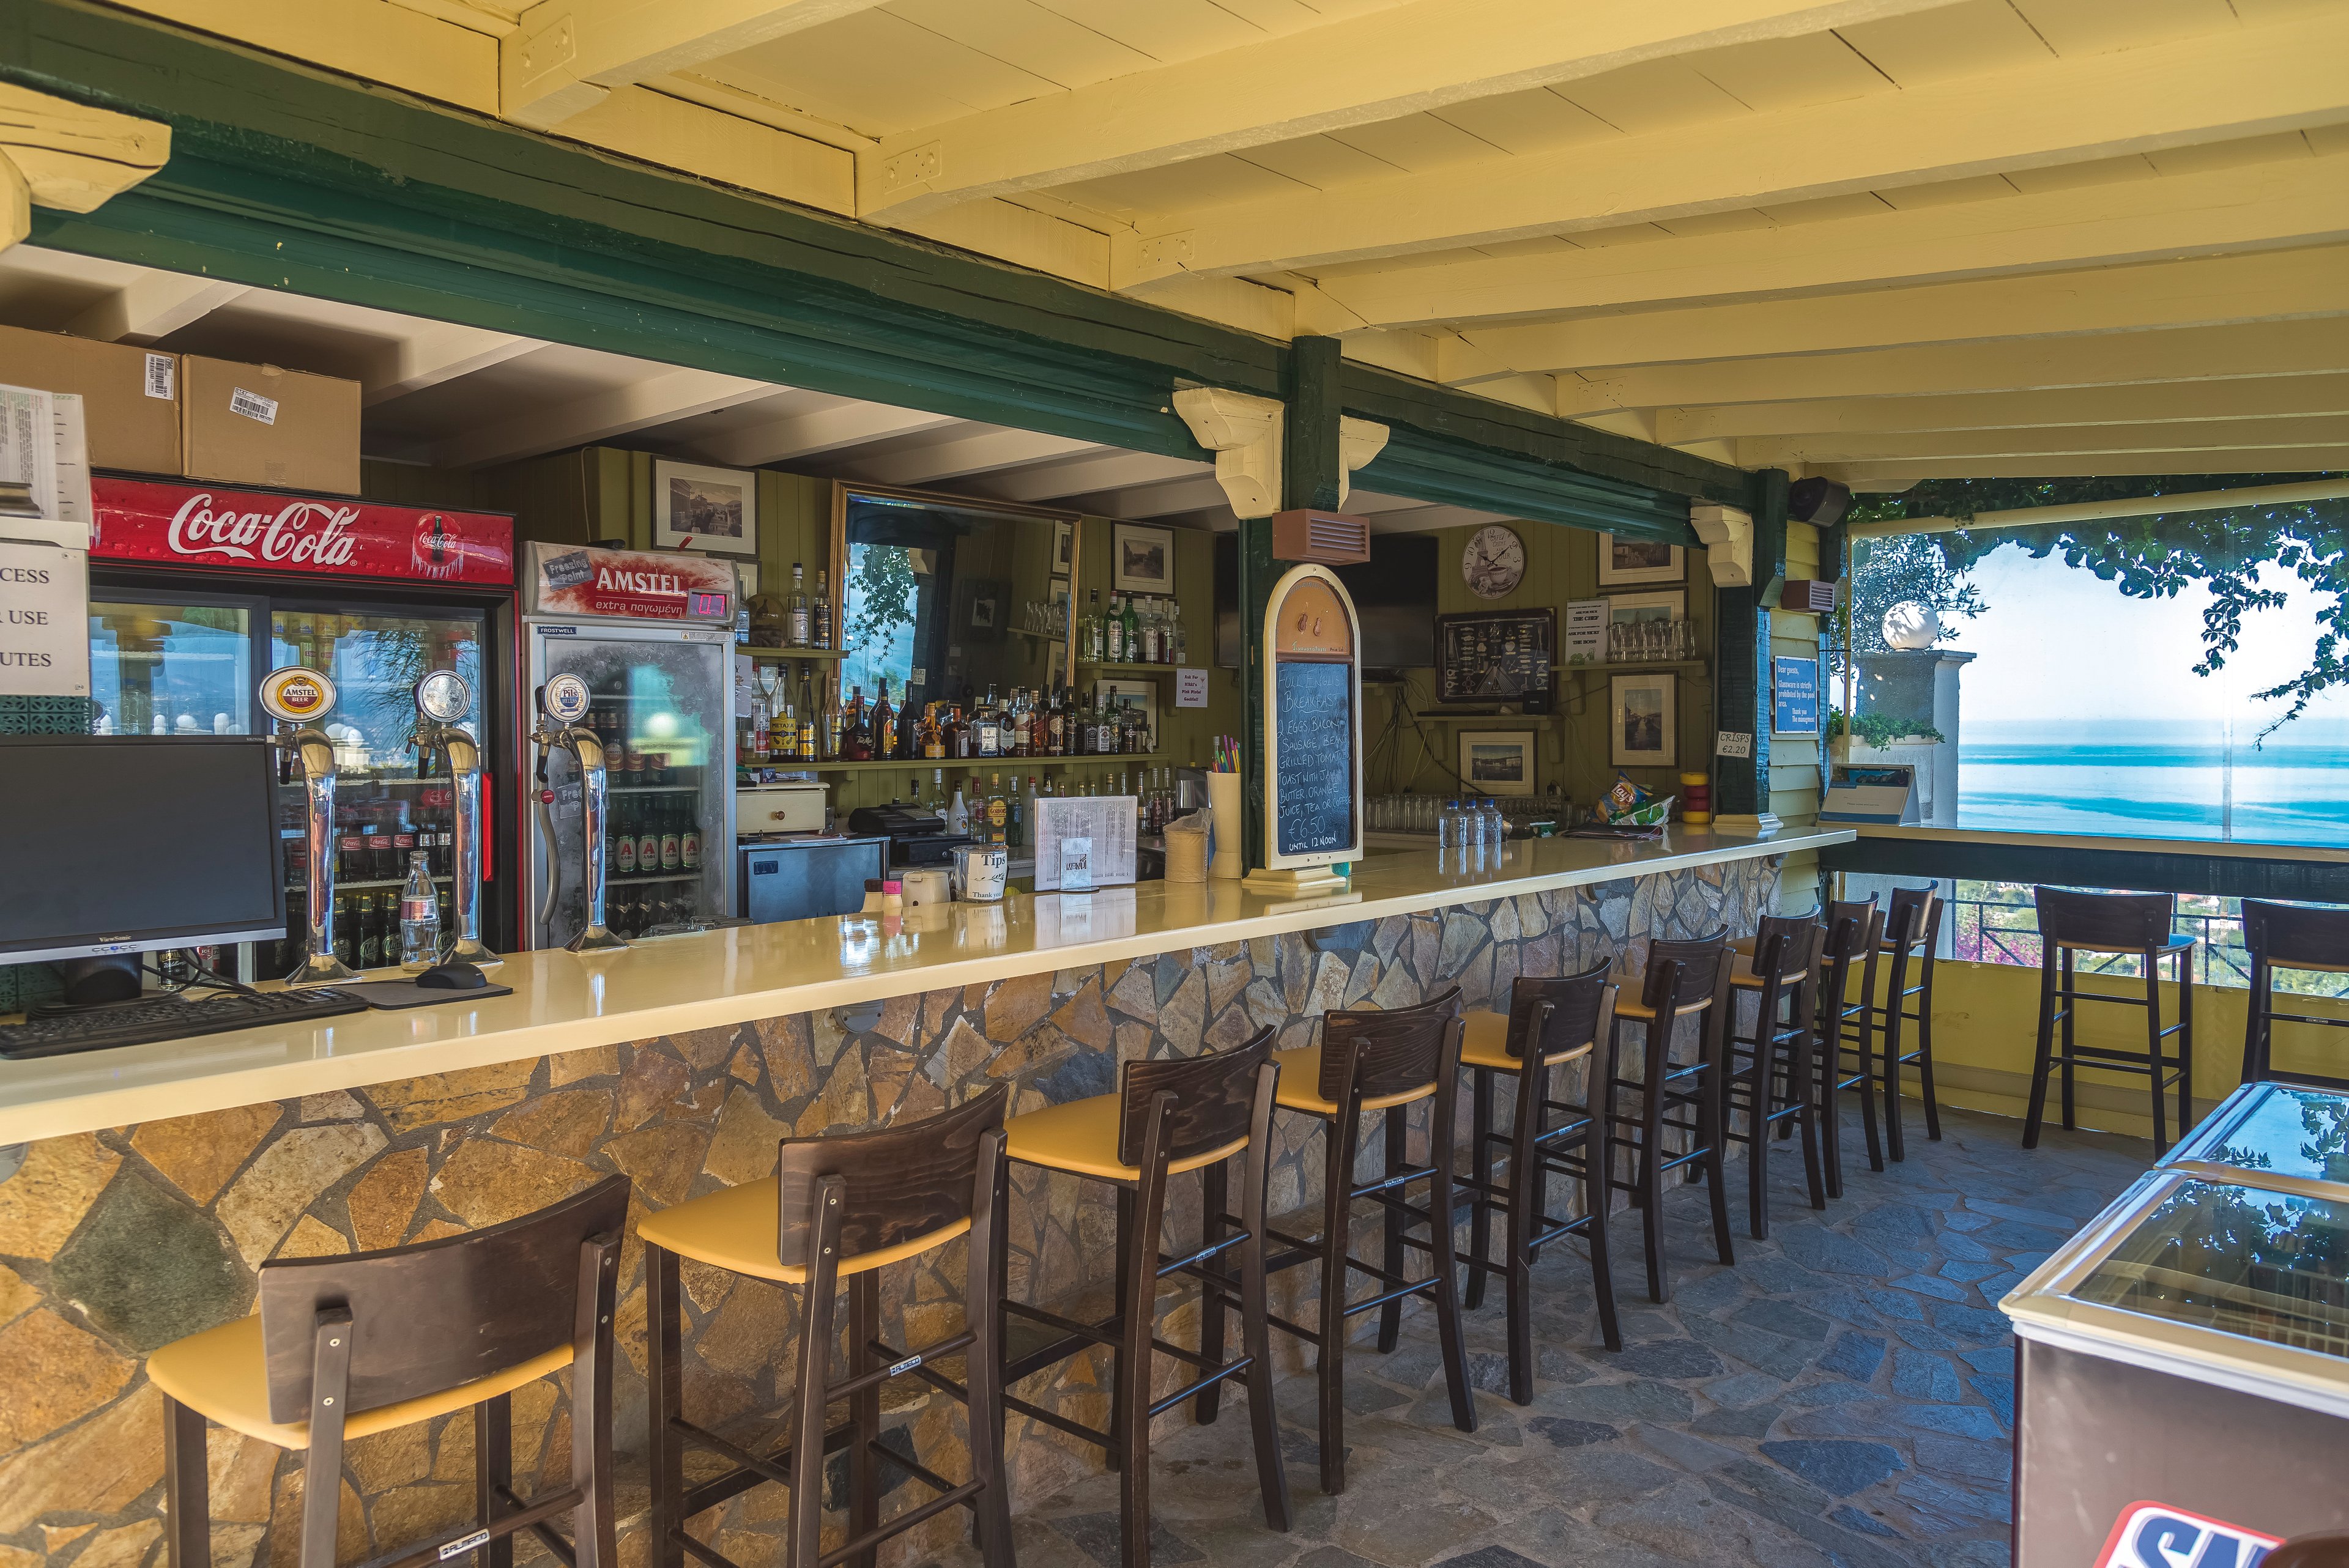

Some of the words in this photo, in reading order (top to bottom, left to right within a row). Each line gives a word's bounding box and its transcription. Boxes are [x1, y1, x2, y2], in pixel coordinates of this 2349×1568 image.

[168, 494, 360, 566] Coca-Cola
[596, 568, 686, 594] AMSTEL
[596, 601, 626, 611] extra
[631, 602, 683, 616] παγωμένη
[9, 610, 49, 625] USE
[1787, 667, 1799, 675] guests,
[1278, 670, 1304, 689] FULL
[1778, 680, 1796, 689] Glassware
[1282, 691, 1341, 712] BREAKFAST
[1797, 690, 1801, 700] by
[1277, 719, 1285, 739] 2
[1720, 733, 1750, 742] CRISPS
[1282, 738, 1320, 753] SAUSAGE,
[1722, 745, 1746, 754] €2.20
[1278, 754, 1314, 769] GRILLED
[1278, 771, 1302, 786] TOAST
[1302, 772, 1319, 783] WITH
[1308, 783, 1339, 798] ORANGE
[1278, 804, 1303, 819] JUICE,
[1305, 802, 1320, 815] TEA
[1322, 799, 1332, 810] OR
[1288, 816, 1326, 841] €6.50
[1289, 842, 1308, 851] UNTIL
[1312, 837, 1319, 847] 12
[1319, 830, 1337, 846] NOON
[981, 854, 1005, 869] Tips
